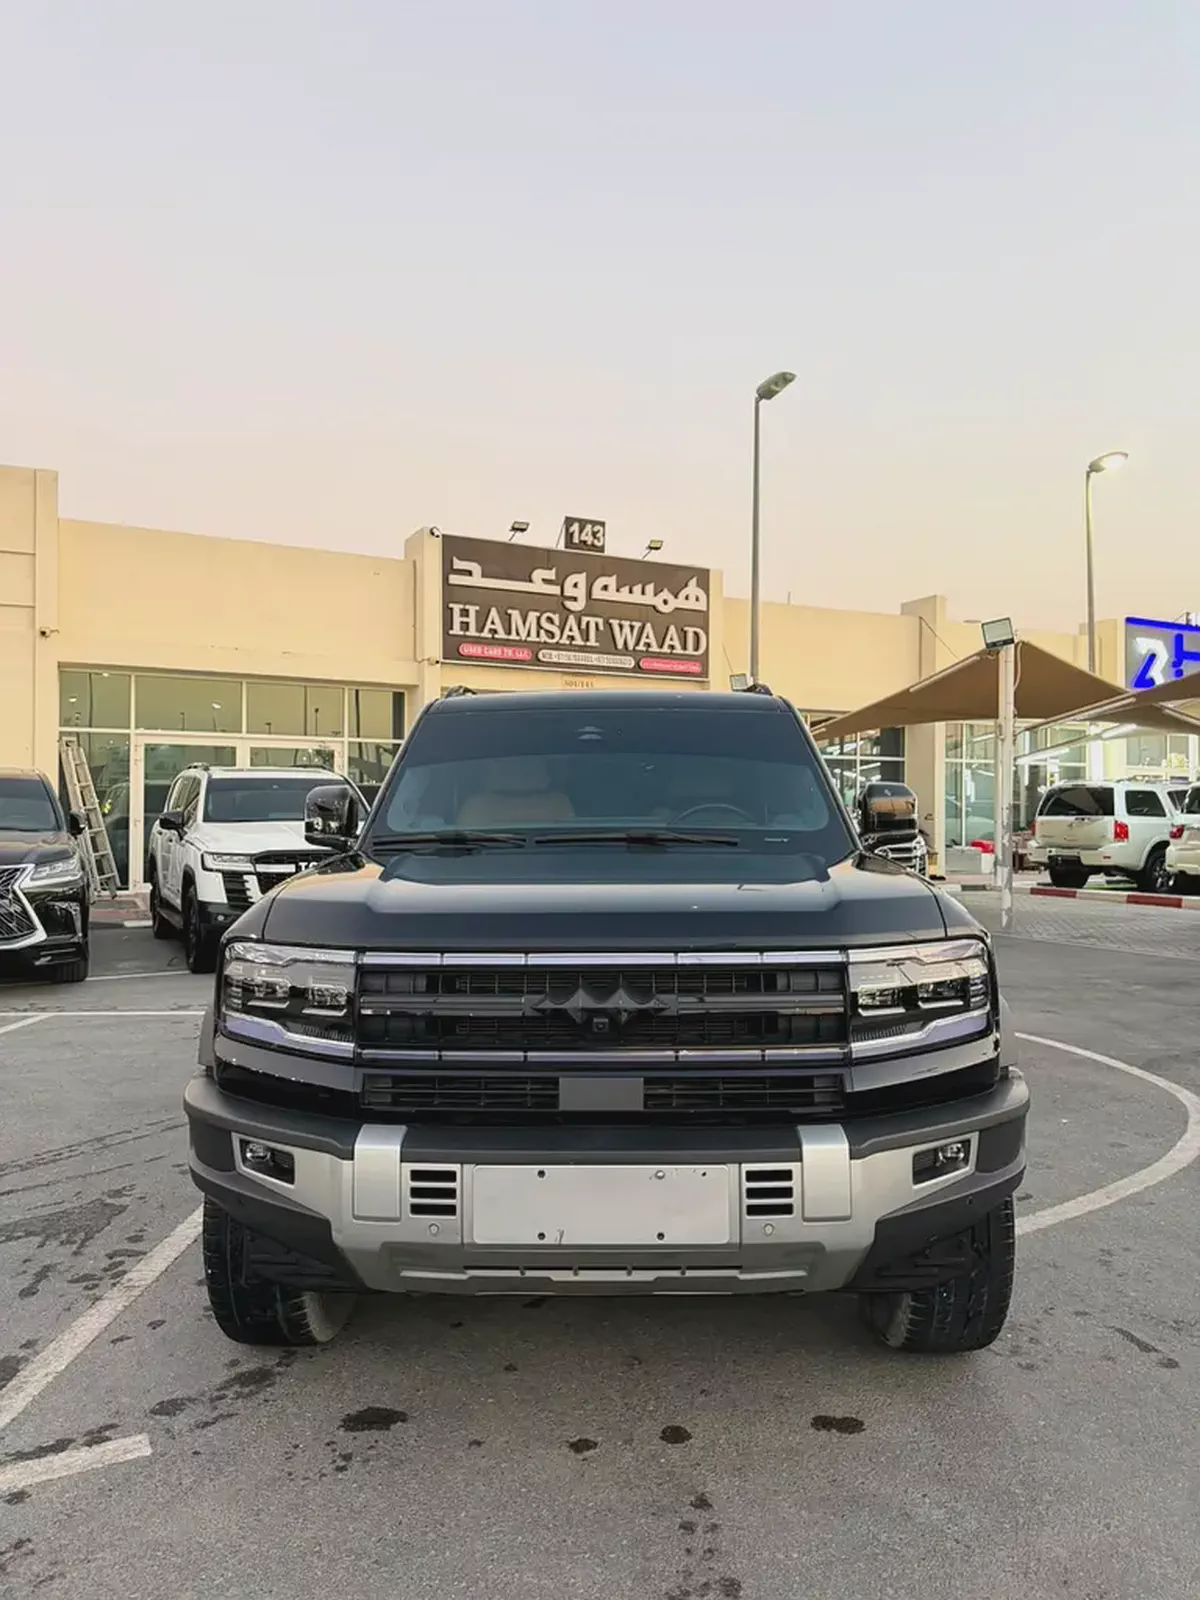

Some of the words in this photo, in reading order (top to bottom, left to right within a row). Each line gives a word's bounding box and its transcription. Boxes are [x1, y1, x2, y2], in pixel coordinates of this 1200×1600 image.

[569, 522, 604, 547] 143
[448, 603, 604, 646] HAMSAT
[608, 619, 707, 656] WAAD
